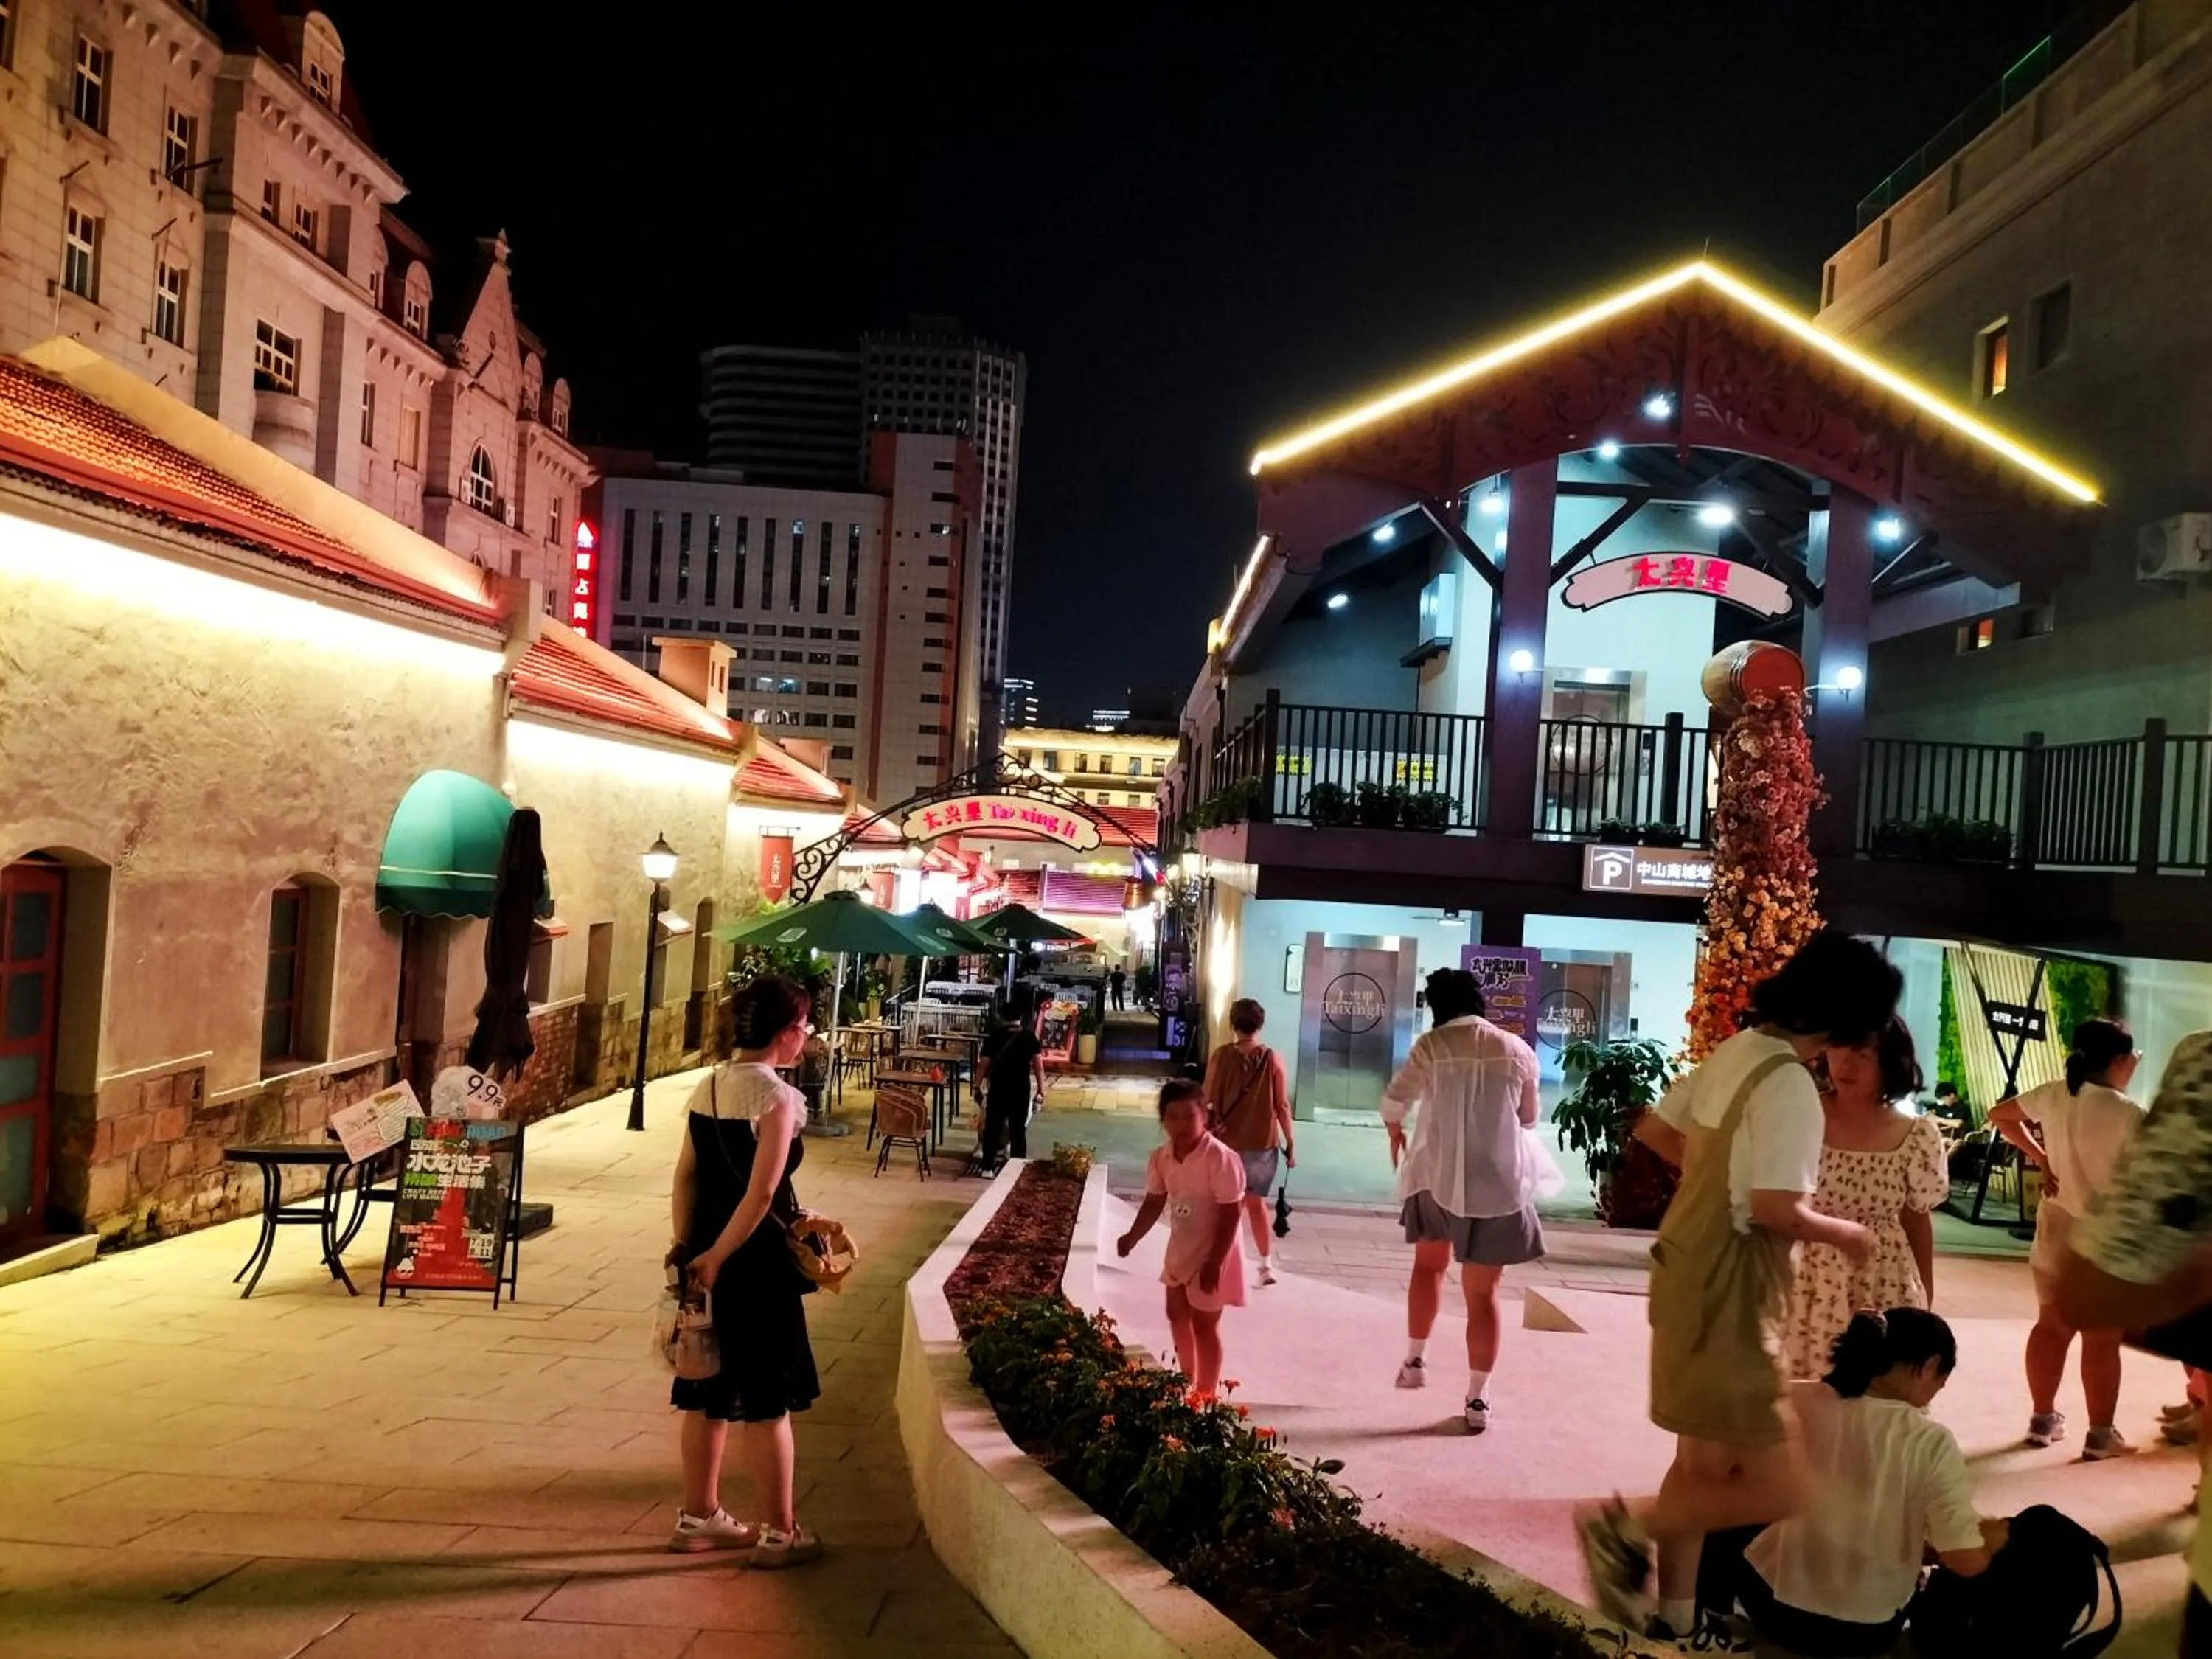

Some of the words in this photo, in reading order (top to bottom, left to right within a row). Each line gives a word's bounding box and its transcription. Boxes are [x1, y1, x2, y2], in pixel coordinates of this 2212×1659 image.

[1020, 807, 1060, 832] xing
[1062, 820, 1078, 839] li
[406, 1151, 493, 1175] 水龙池子
